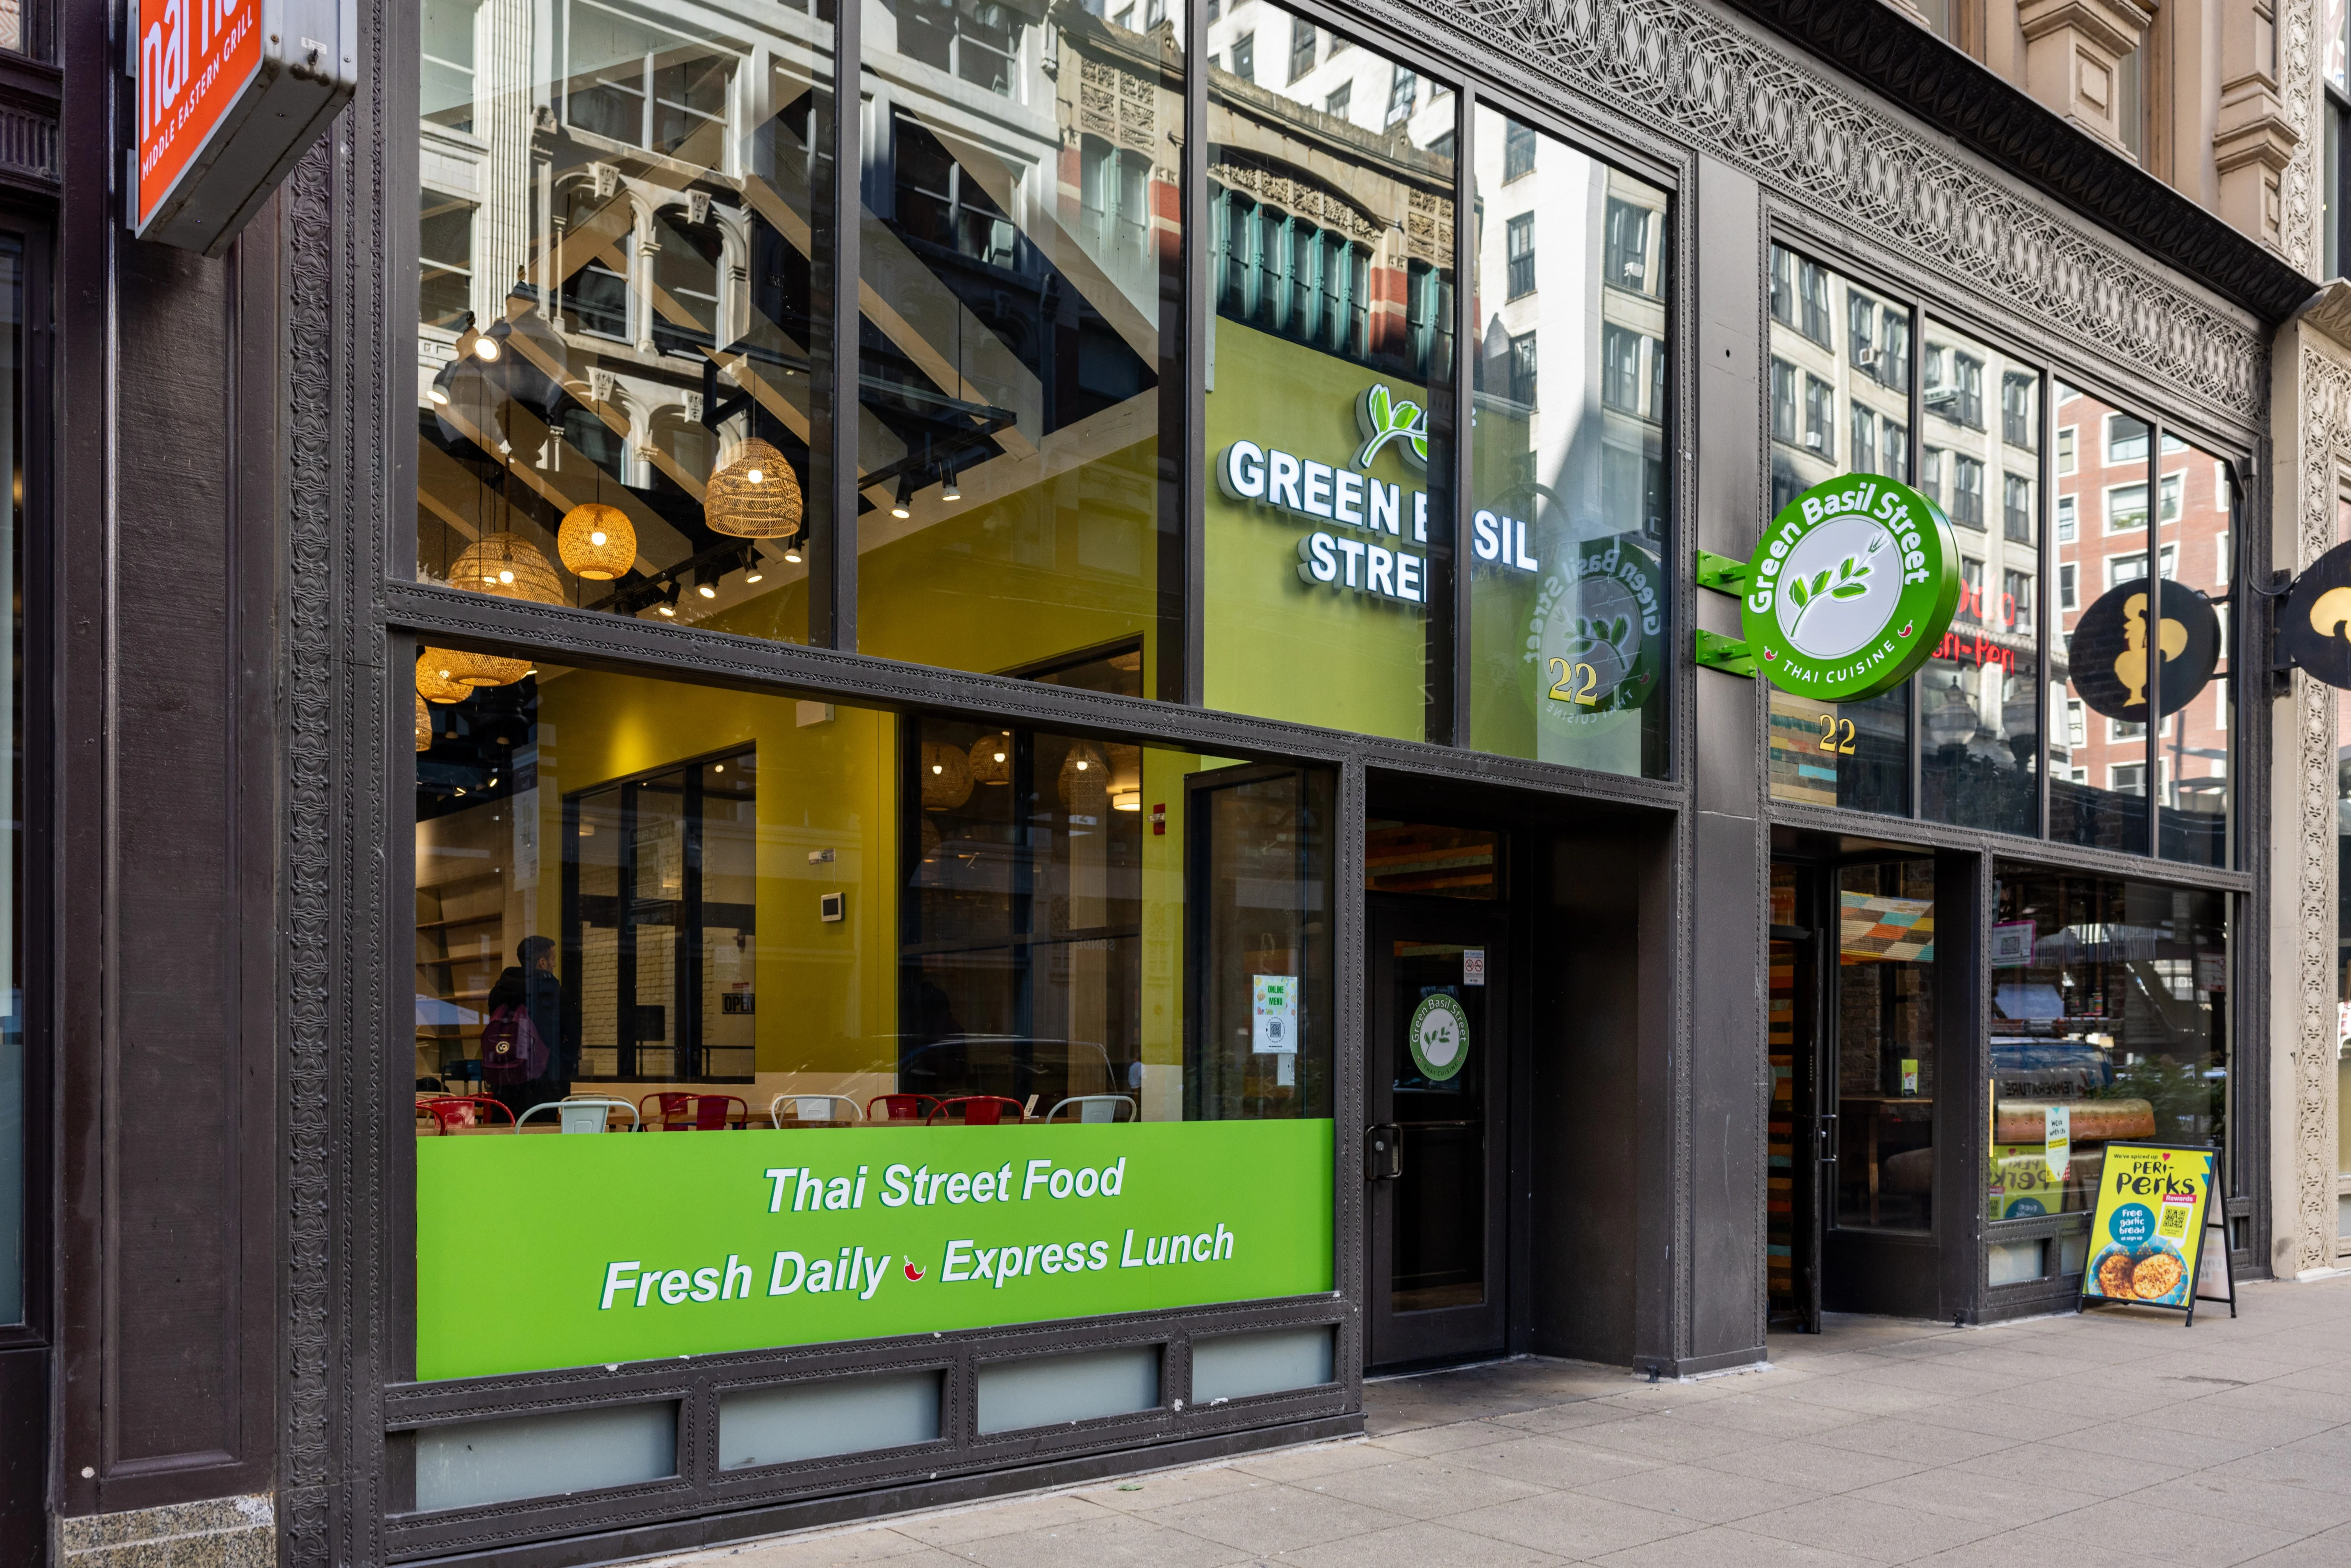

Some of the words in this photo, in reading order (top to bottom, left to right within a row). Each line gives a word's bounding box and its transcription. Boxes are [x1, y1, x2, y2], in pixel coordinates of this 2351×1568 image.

[143, 119, 175, 181] MIDDLE
[178, 52, 219, 131] EASTERN
[223, 5, 253, 62] GRILL
[1228, 439, 1401, 536] GREEN
[1309, 532, 1428, 604] STRE
[1748, 522, 1802, 614] Green
[1801, 483, 1877, 526] Basil
[1873, 492, 1930, 585] Street
[1549, 657, 1598, 707] 22
[1783, 659, 1818, 683] THAI
[1826, 639, 1895, 684] CUISINE
[1819, 714, 1856, 755] 22
[724, 996, 755, 1012] OPEN
[1268, 985, 1284, 994] ONLINE
[1269, 997, 1283, 1005] MENU
[1412, 1007, 1428, 1043] Green
[1428, 998, 1451, 1010] Basil
[1451, 1004, 1467, 1042] Street
[1424, 1064, 1435, 1076] THAI
[1437, 1062, 1458, 1076] CUISINE
[763, 1165, 868, 1213] Thai
[879, 1161, 1011, 1208] Street
[1021, 1156, 1126, 1201] Food
[2116, 1172, 2195, 1195] Perks
[2119, 1226, 2145, 1234] bread
[2120, 1217, 2144, 1227] garlic
[598, 1253, 752, 1310] Fresh
[766, 1246, 891, 1301] Daily
[939, 1238, 1108, 1289] Express
[1119, 1222, 1235, 1269] Lunch
